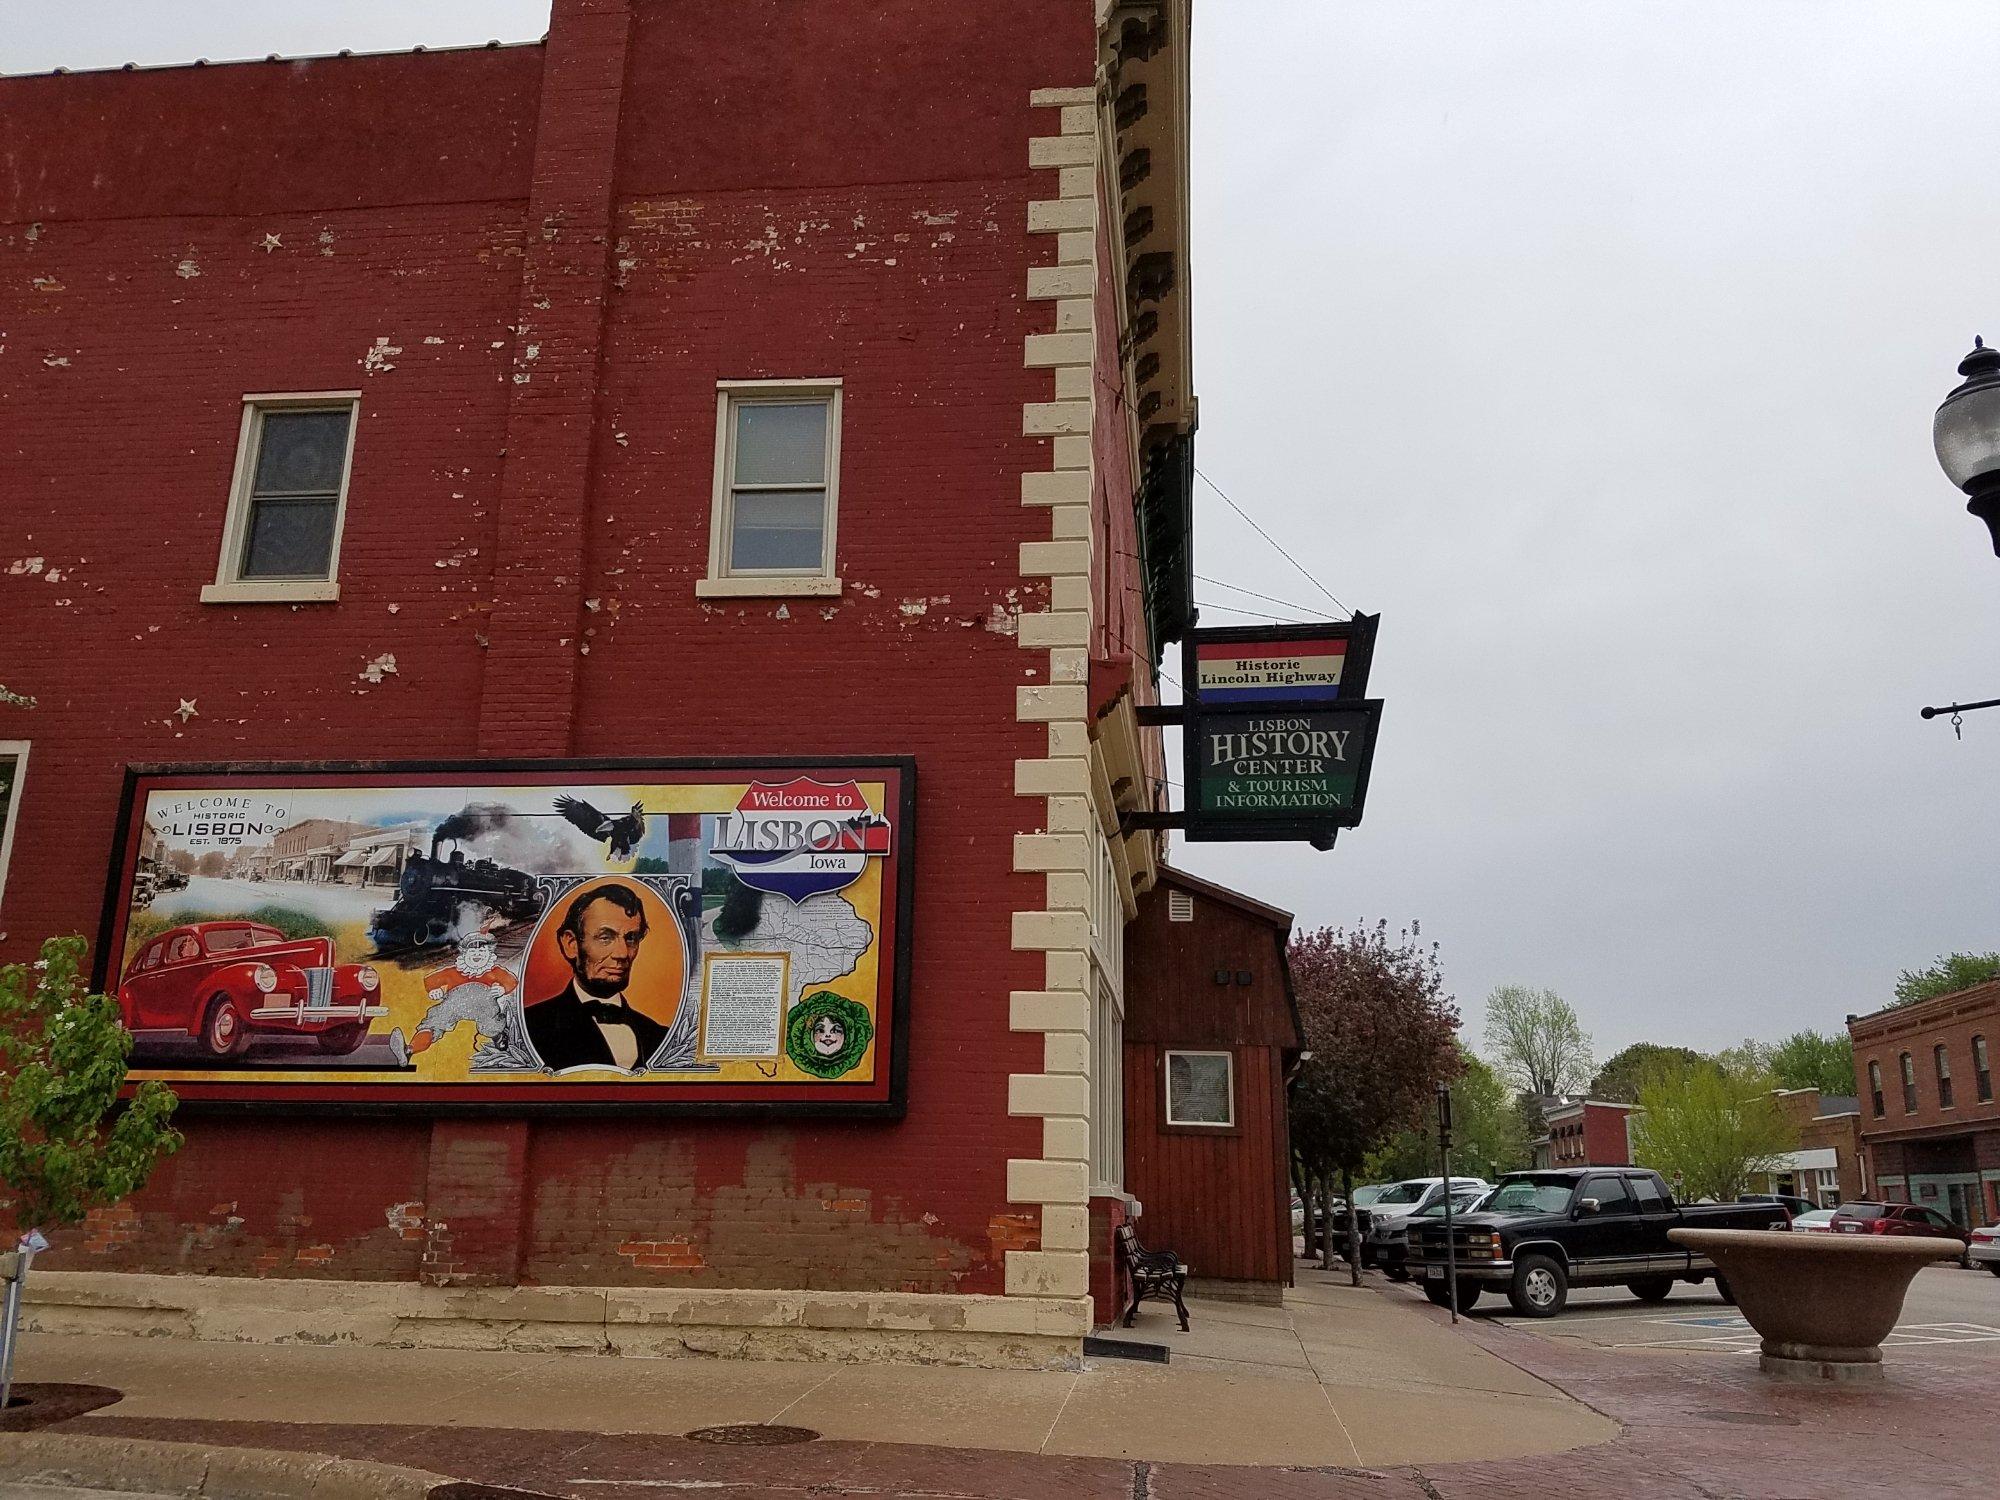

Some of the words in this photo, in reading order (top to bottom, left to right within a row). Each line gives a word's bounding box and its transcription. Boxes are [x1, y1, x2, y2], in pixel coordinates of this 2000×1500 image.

[1236, 660, 1300, 671] Historic
[1201, 673, 1261, 684] Lincoln
[1266, 671, 1336, 684] Highway
[1247, 718, 1311, 732] LISBON
[1210, 730, 1350, 766] HISTORY
[1233, 759, 1325, 775] CENTER
[1228, 780, 1240, 792] &
[1246, 778, 1328, 792] TOURISM
[752, 791, 829, 807] Welcome
[835, 792, 852, 806] to
[1216, 793, 1342, 807] INFORMATION
[157, 797, 252, 819] WELCOME
[264, 803, 286, 819] TO
[172, 822, 264, 836] LISBON
[717, 816, 867, 851] LISBON
[218, 837, 242, 845] 1875
[809, 855, 846, 869] Iowa
